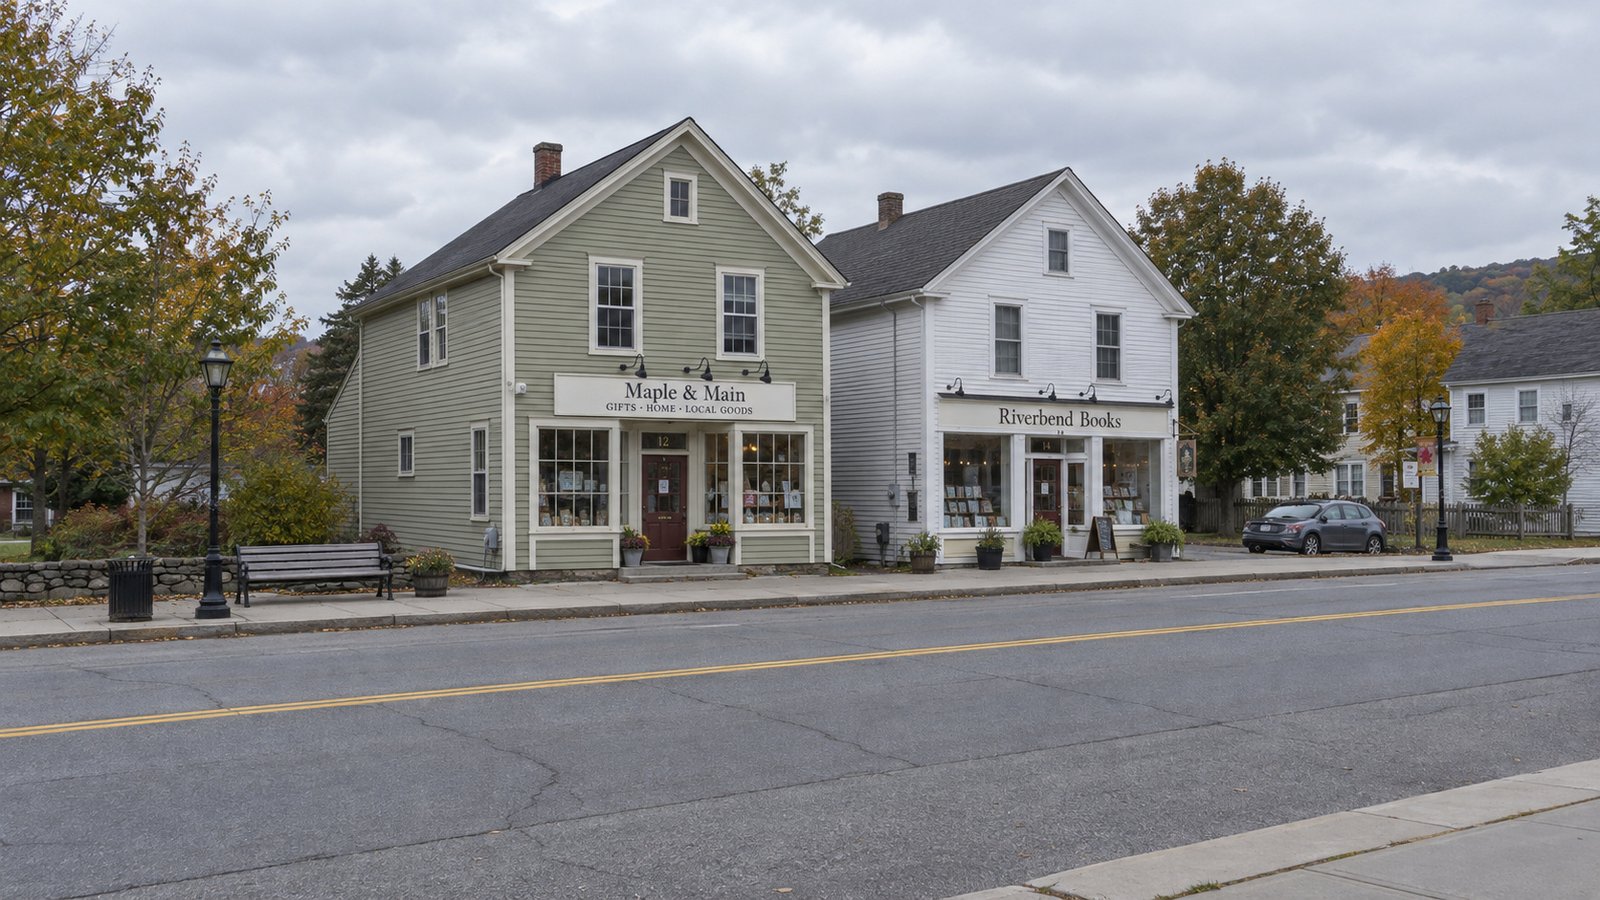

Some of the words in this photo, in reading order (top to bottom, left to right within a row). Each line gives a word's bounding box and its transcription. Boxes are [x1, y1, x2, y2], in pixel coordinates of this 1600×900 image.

[625, 382, 677, 403] Maple
[683, 385, 698, 400] &
[704, 385, 745, 402] Main
[606, 402, 636, 411] GIFTS
[646, 404, 676, 412] HOME
[685, 405, 716, 413] LOCAL
[720, 406, 753, 414] GOODS
[999, 408, 1074, 426] Riverbend
[1080, 411, 1121, 428] Books
[658, 436, 669, 447] 12
